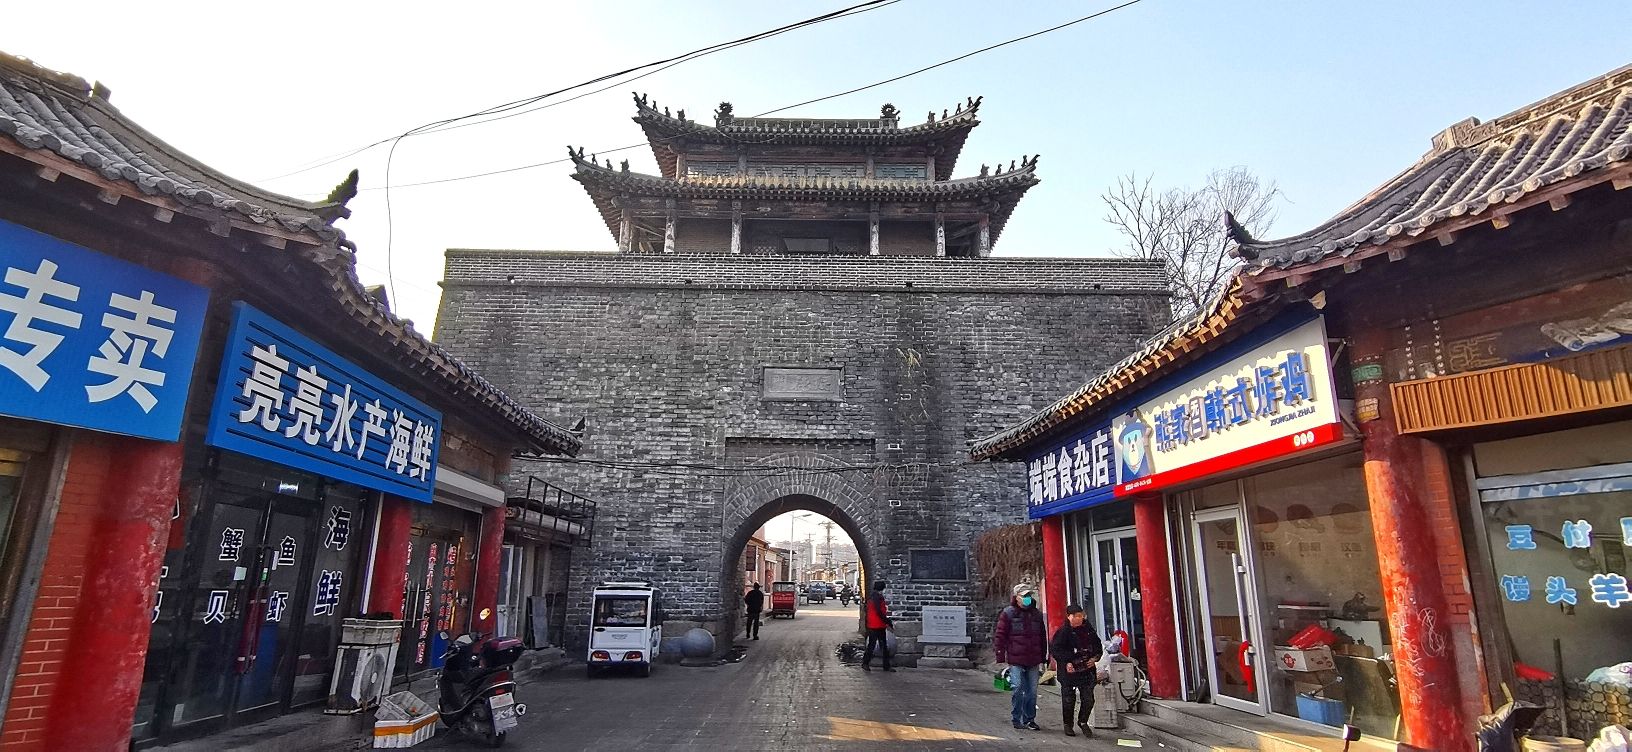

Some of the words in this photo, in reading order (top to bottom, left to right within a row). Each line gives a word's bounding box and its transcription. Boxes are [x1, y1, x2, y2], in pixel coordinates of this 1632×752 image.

[0, 259, 177, 414] 专卖
[239, 345, 433, 482] 亮亮水产海鲜
[1029, 430, 1109, 505] 端端食杂店
